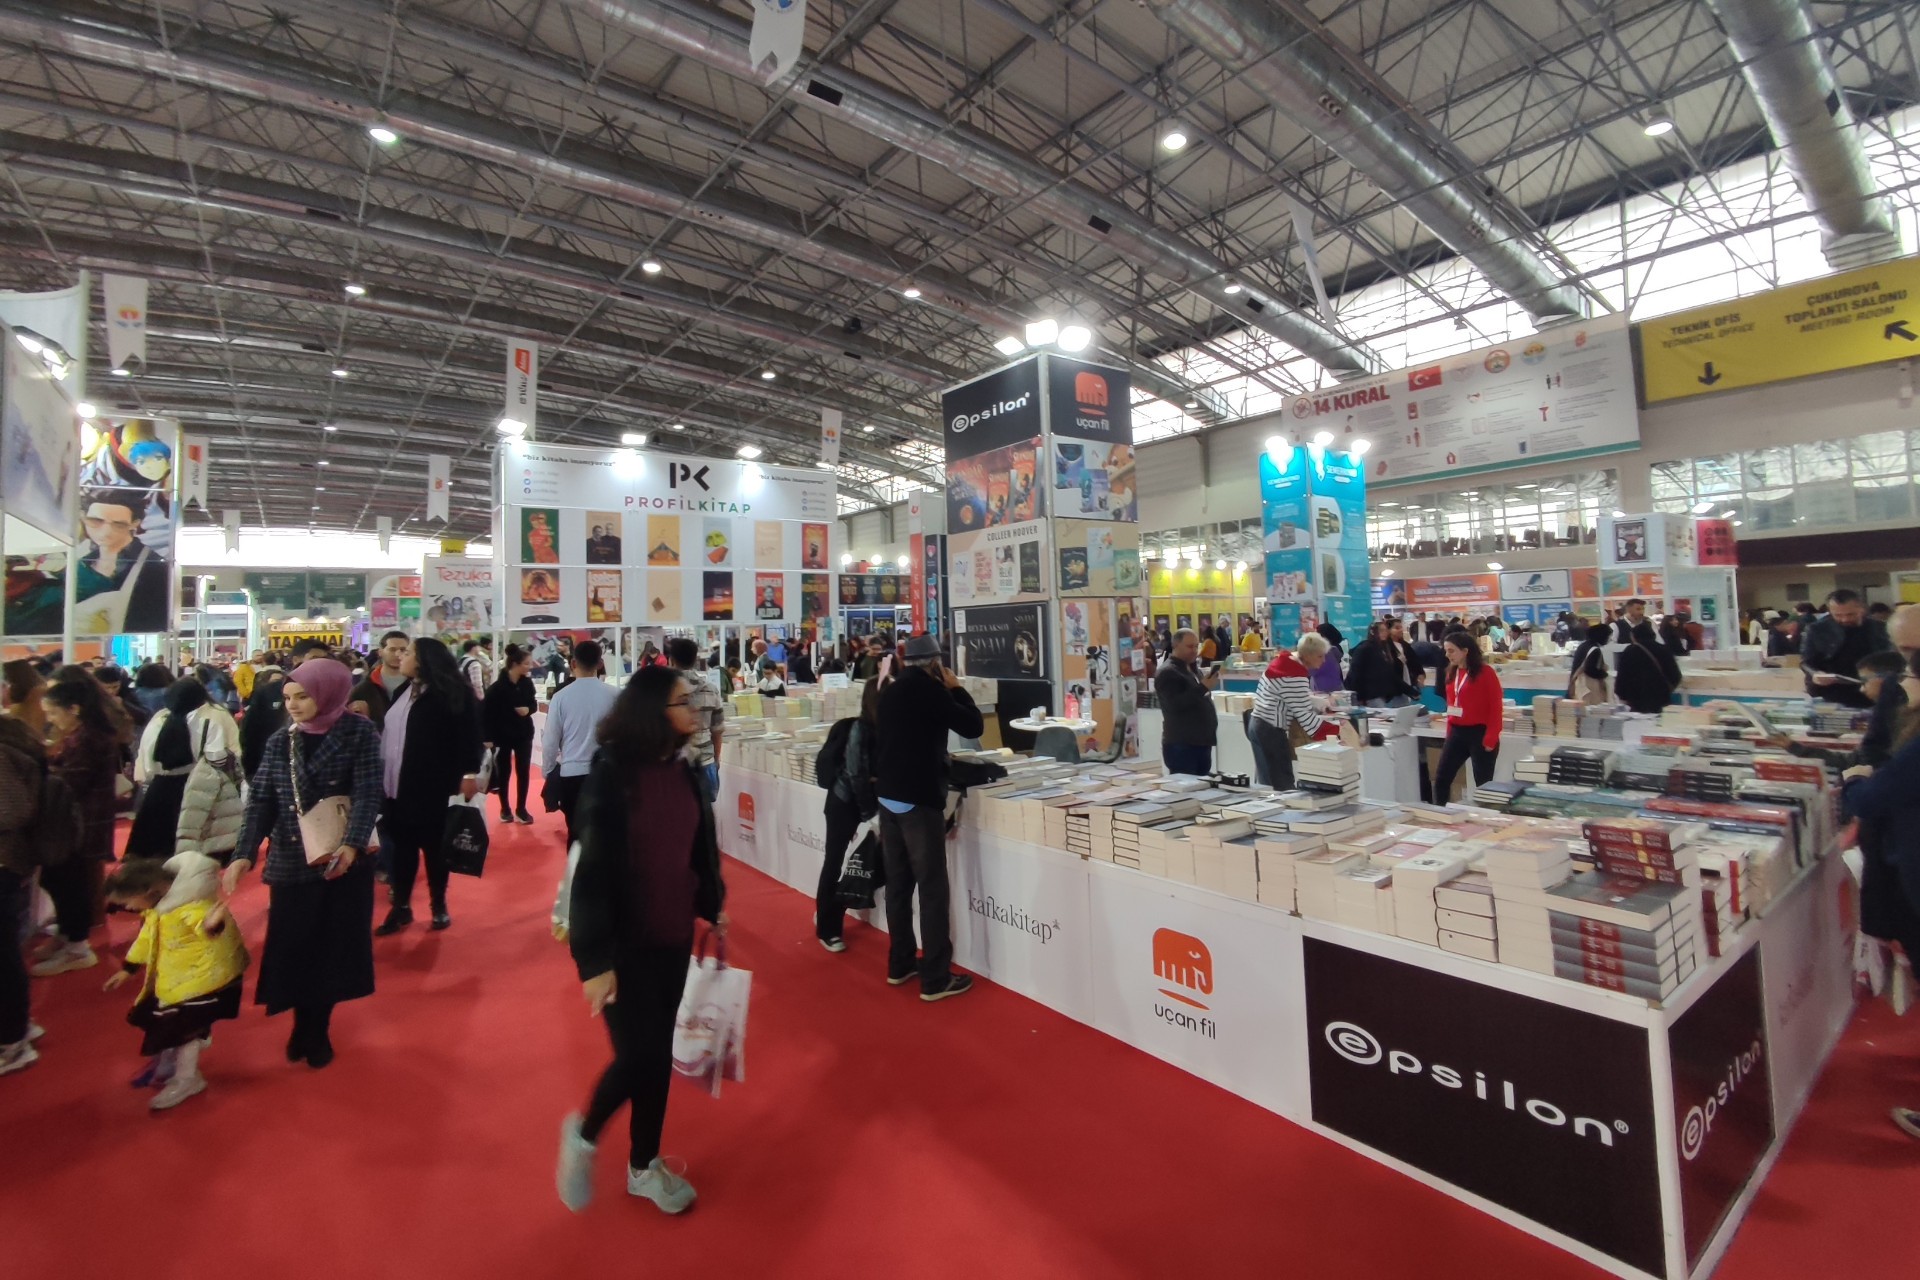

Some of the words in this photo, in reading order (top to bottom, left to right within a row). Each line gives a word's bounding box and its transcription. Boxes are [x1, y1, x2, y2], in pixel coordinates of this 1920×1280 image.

[1785, 303, 1849, 324] TOPLANTI
[1851, 289, 1908, 310] SALONU
[1806, 281, 1880, 306] ÇUKUROVA
[1671, 320, 1712, 336] TEKNİK
[1714, 312, 1741, 327] OFİS
[1800, 314, 1853, 333] MEETING
[1855, 305, 1895, 321] ROOM
[1662, 331, 1715, 349] TECHNICAL
[1718, 322, 1755, 338] OFFICE
[1313, 398, 1331, 416] 14
[1333, 385, 1390, 411] KURAL
[624, 494, 751, 514] PROFİLKİTAP
[986, 529, 1011, 542] COLLEEN
[1012, 525, 1038, 537] HOOVER
[1517, 585, 1553, 594] ADEDA
[1154, 1003, 1197, 1030] uçan
[1199, 1018, 1217, 1040] fil
